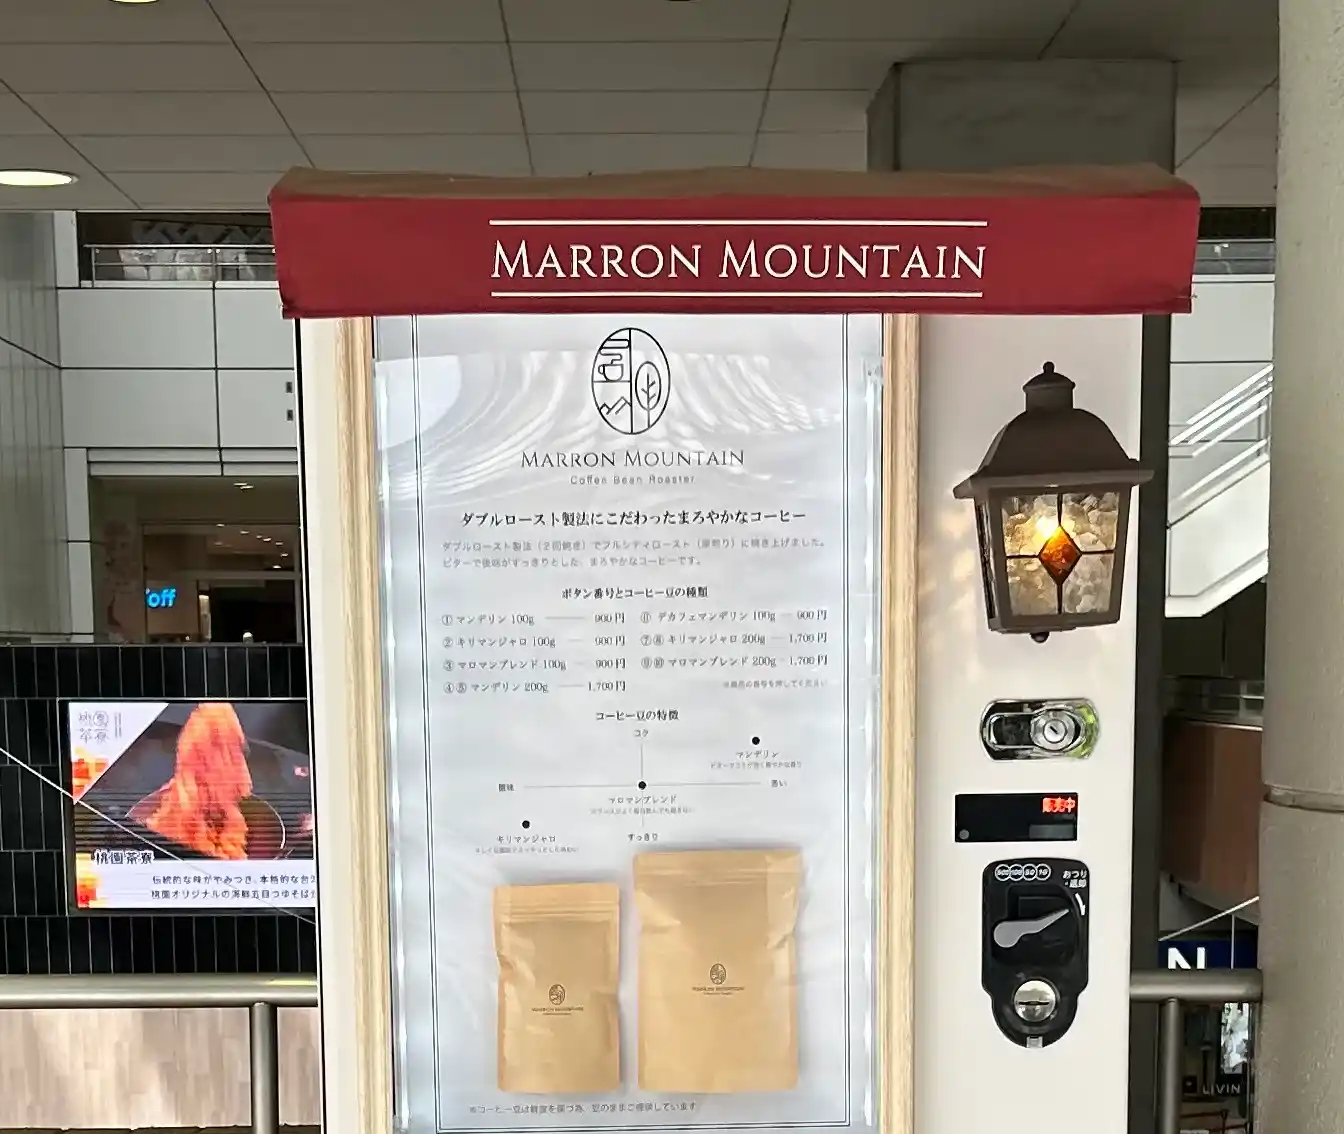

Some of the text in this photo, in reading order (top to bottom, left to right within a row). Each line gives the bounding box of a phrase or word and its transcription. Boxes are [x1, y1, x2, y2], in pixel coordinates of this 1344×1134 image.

[491, 237, 987, 281] MARRON MOUNTAIN
[521, 450, 745, 468] MARRON MOUNTAIN
[570, 475, 695, 485] Coffee Bean Roaster
[462, 509, 806, 527] ダブルロースト製法にこだわったまろやかなコーヒー
[457, 614, 506, 624] マンデリン
[457, 637, 527, 648] キリマンジャロ
[667, 634, 737, 644] キリマンジャロ
[471, 682, 521, 692] マンデリン
[596, 710, 679, 721] コーヒー豆の特徴
